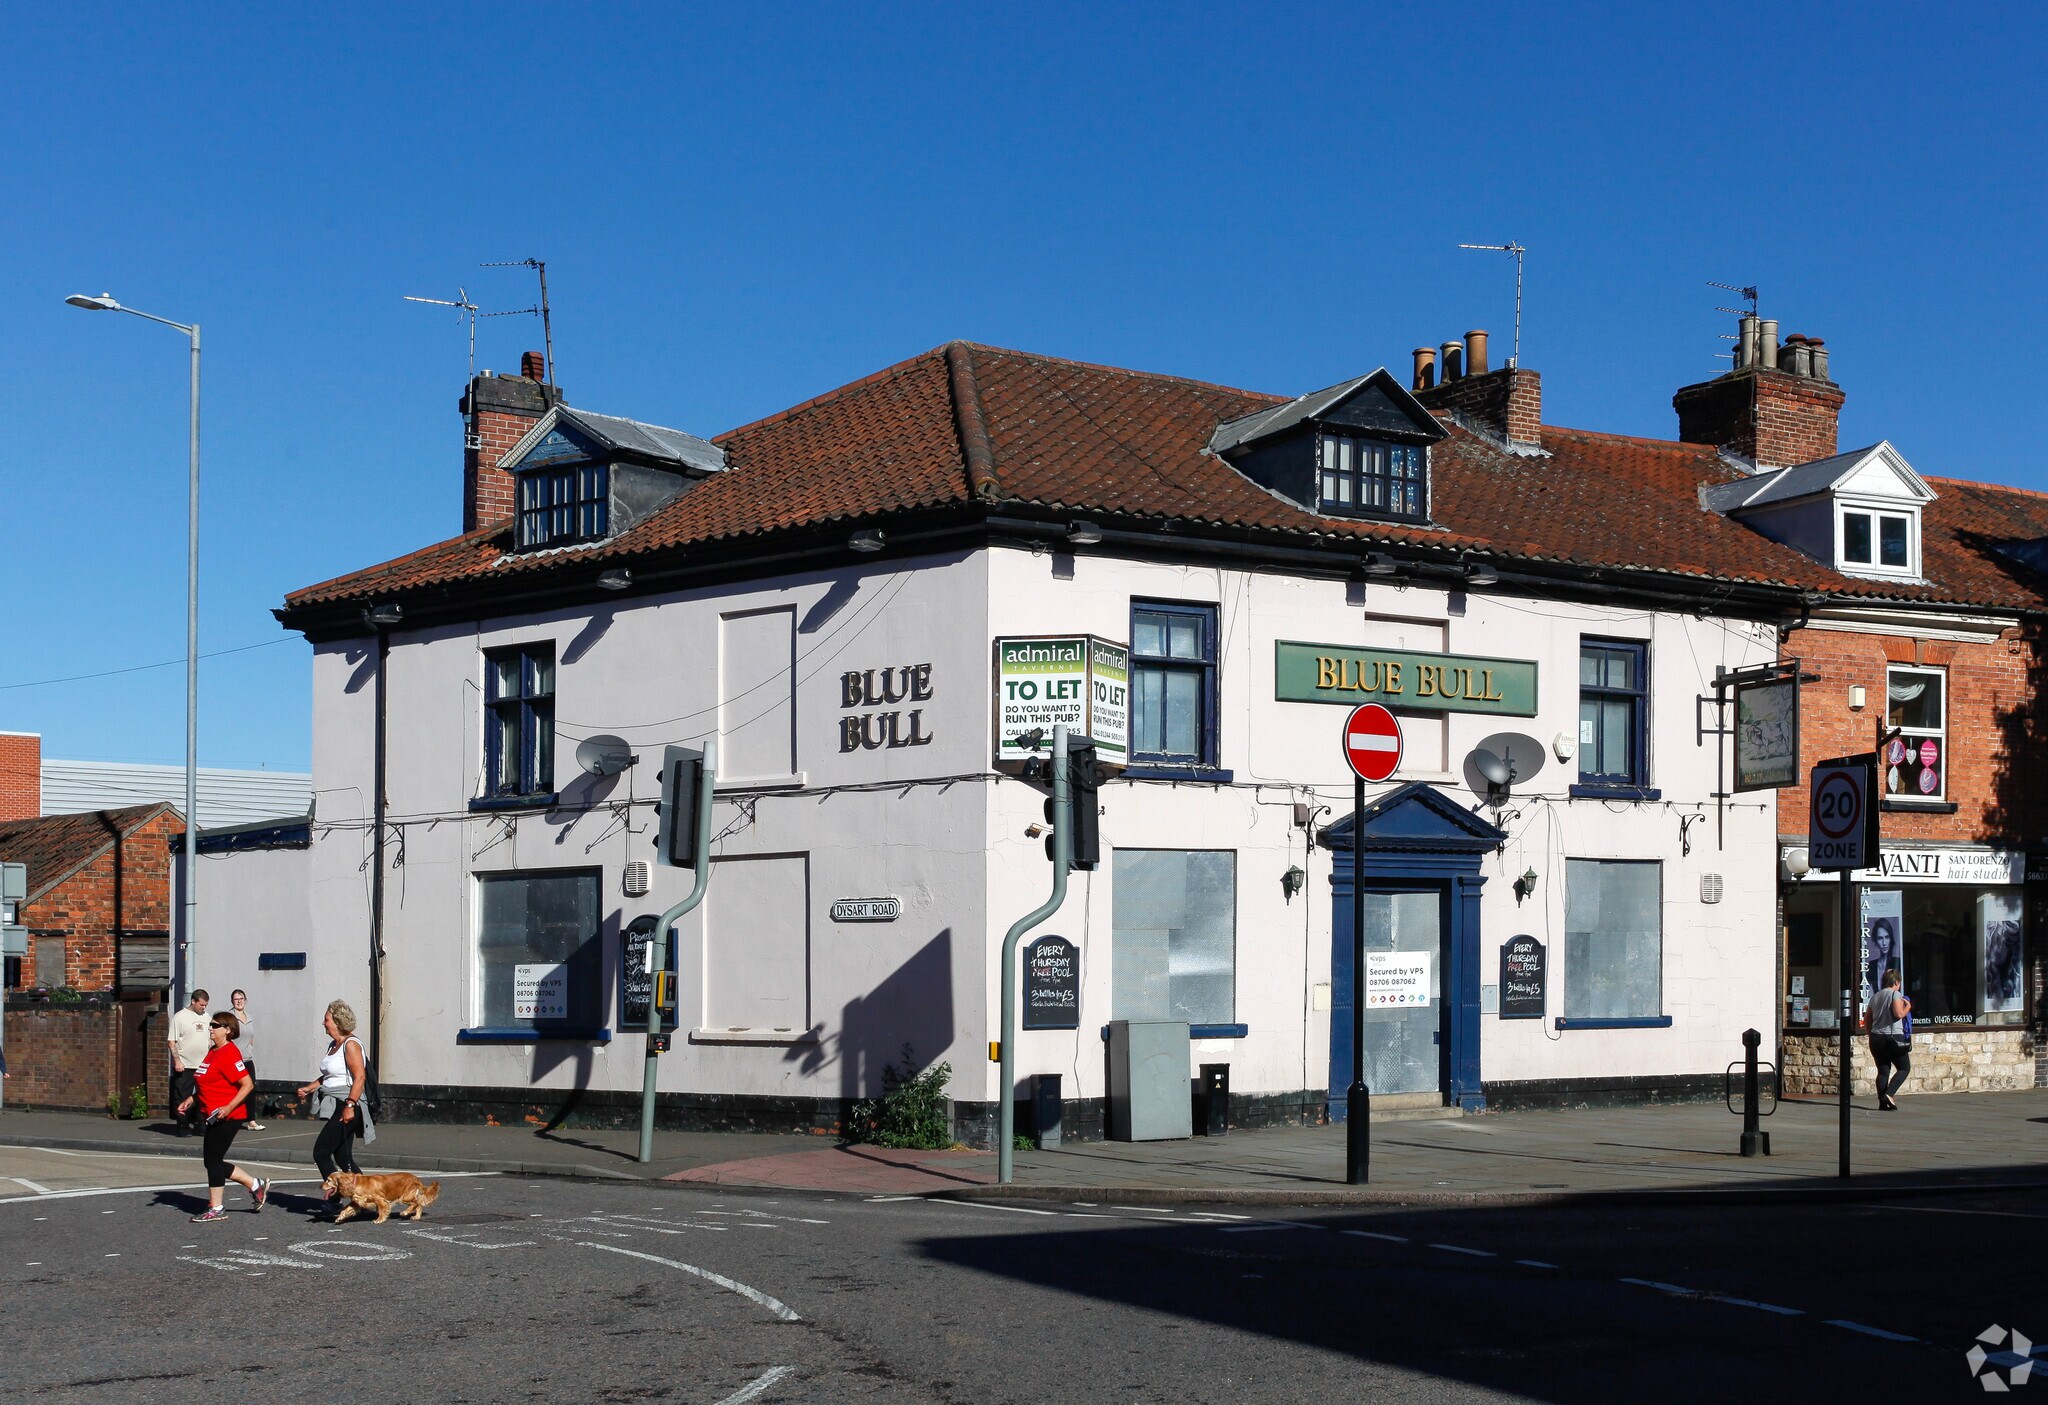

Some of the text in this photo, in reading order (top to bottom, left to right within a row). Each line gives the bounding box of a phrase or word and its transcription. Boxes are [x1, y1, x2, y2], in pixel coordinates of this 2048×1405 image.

[1006, 644, 1080, 662] admiral
[1094, 648, 1125, 670] admiral
[840, 662, 934, 708] BLUE
[1316, 656, 1504, 701] BLUE BULL
[1006, 680, 1081, 700] TO LET
[1094, 680, 1125, 707] TO LET
[1021, 705, 1039, 713] YOU
[1042, 704, 1067, 712] WANT
[1070, 704, 1081, 712] TO
[1093, 705, 1099, 713] DO
[1108, 709, 1118, 718] WANT
[1119, 711, 1125, 719] TO
[1005, 713, 1080, 723] RUN THIS PUB?
[1093, 714, 1125, 729] RUN THIS PUB?
[838, 709, 934, 754] BULL
[1006, 728, 1022, 736] CALL
[1821, 791, 1854, 819] 20
[1814, 843, 1857, 859] ZONE
[1867, 854, 1940, 877] VANTI
[1949, 855, 2010, 866] SAN LORENZO
[1948, 868, 2009, 880] hair studio
[837, 903, 895, 916] DYSART ROAD
[1037, 945, 1065, 958] EVERY
[1514, 943, 1533, 953] EVERY
[1031, 957, 1070, 968] THURSDAY
[1507, 953, 1538, 963] THURSDAY
[1032, 967, 1073, 977] FREE POOL
[1399, 968, 1407, 976] by
[1409, 967, 1424, 975] VPS
[1508, 962, 1540, 972] FREE POOL
[1507, 981, 1513, 994] 3
[1530, 982, 1540, 995] £5
[1031, 989, 1040, 1001] 3
[1062, 989, 1074, 1002] £5
[1952, 1015, 1973, 1023] 566330
